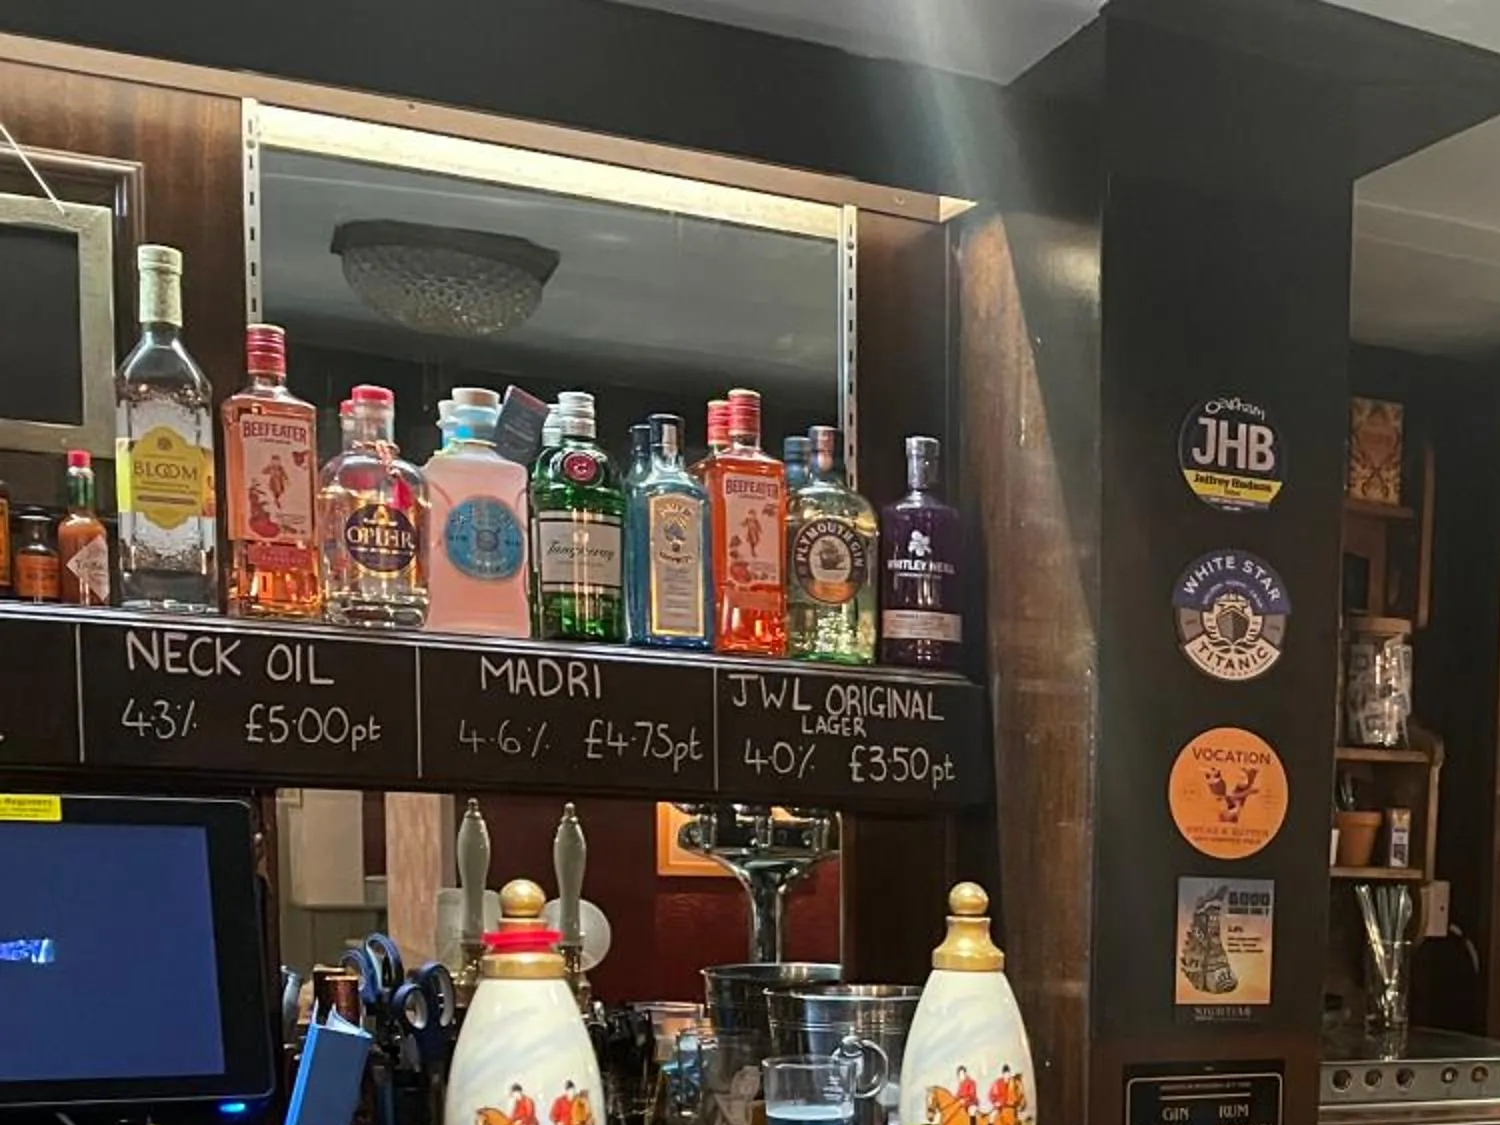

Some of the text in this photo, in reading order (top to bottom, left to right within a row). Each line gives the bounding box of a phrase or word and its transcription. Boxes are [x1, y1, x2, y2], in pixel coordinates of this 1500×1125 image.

[243, 420, 307, 446] BEEFEATER
[1192, 417, 1275, 471] JHB
[133, 459, 198, 481] BLOOM
[796, 522, 865, 567] PLYMOUTH GIN
[1183, 555, 1237, 595] WHITE
[1242, 560, 1281, 602] STAR
[124, 630, 335, 686] NECK OIL
[1198, 640, 1270, 671] TITANIC
[479, 656, 602, 699] MADRI
[728, 673, 945, 723] JWL ORIGINAL
[801, 715, 868, 738] LAGER
[1191, 746, 1272, 765] VOCATION
[1162, 1104, 1250, 1121] GIN RUM
